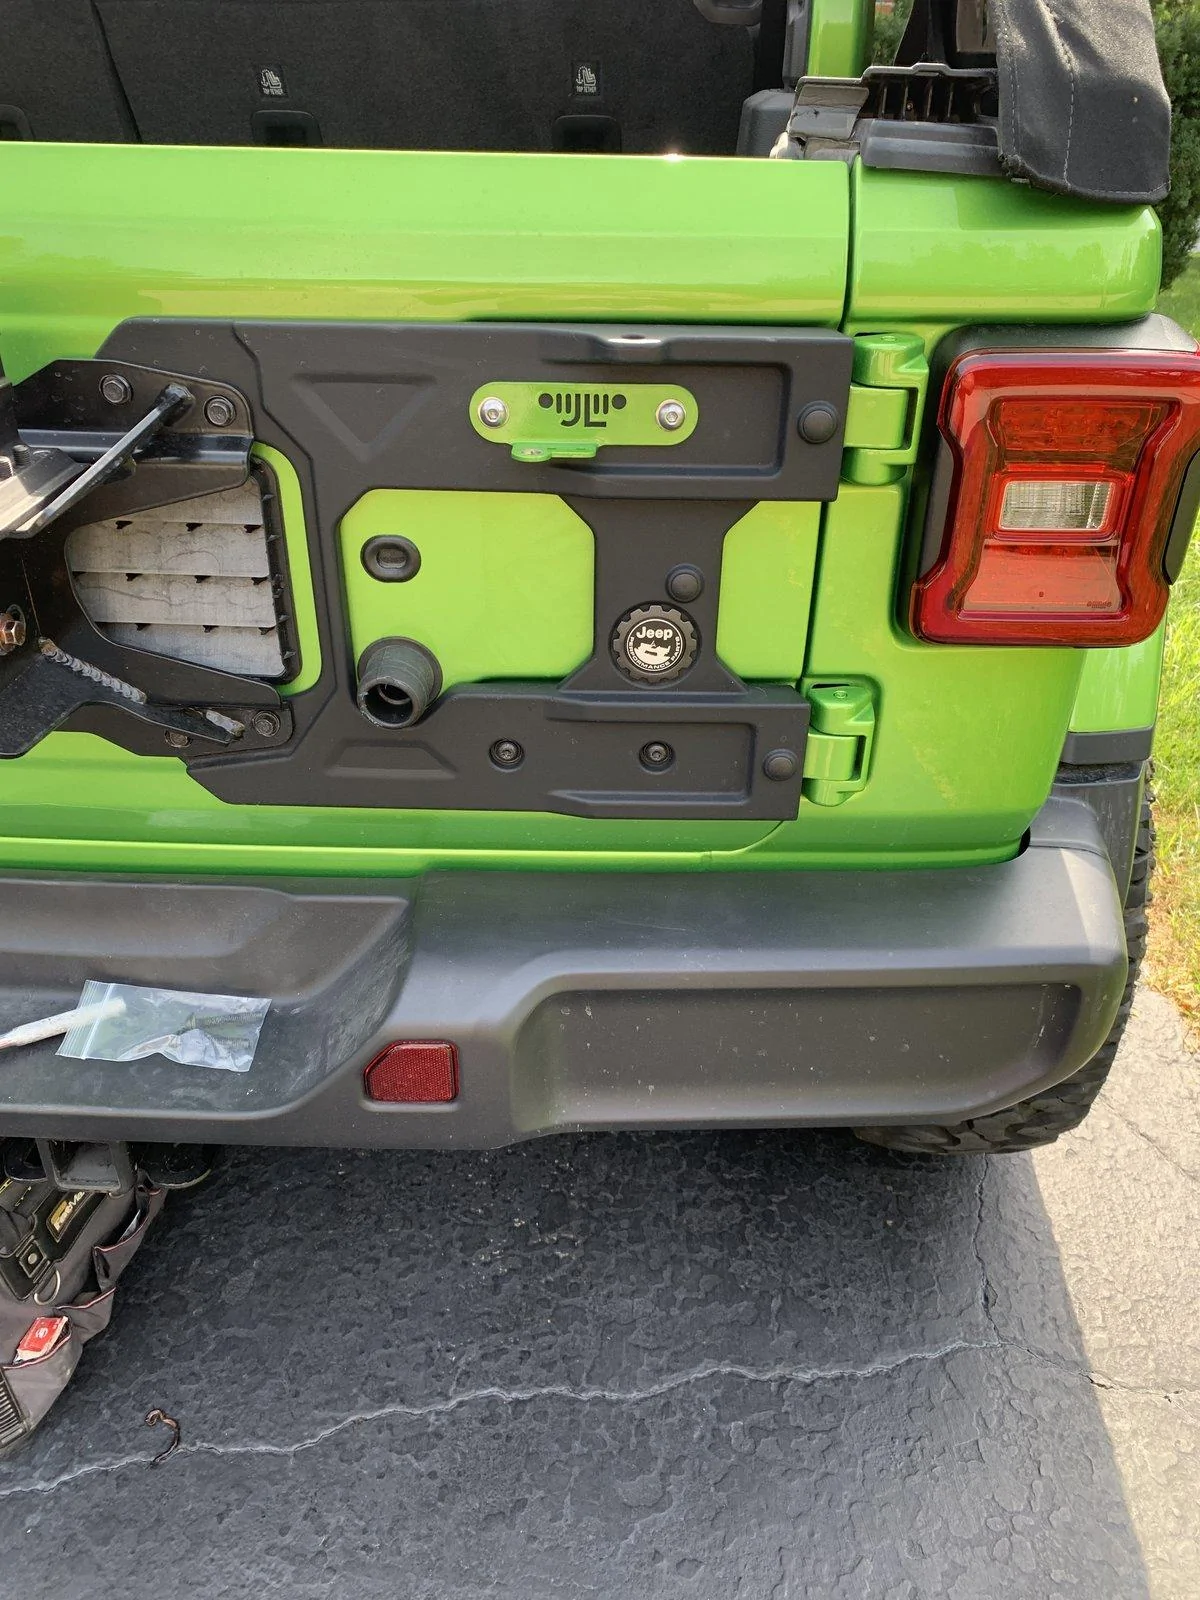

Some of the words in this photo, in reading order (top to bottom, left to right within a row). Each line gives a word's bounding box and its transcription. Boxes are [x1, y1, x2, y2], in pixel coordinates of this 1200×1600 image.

[636, 626, 673, 640] Jeep
[628, 637, 671, 670] PERFORMANCE
[671, 636, 681, 661] PARTS
